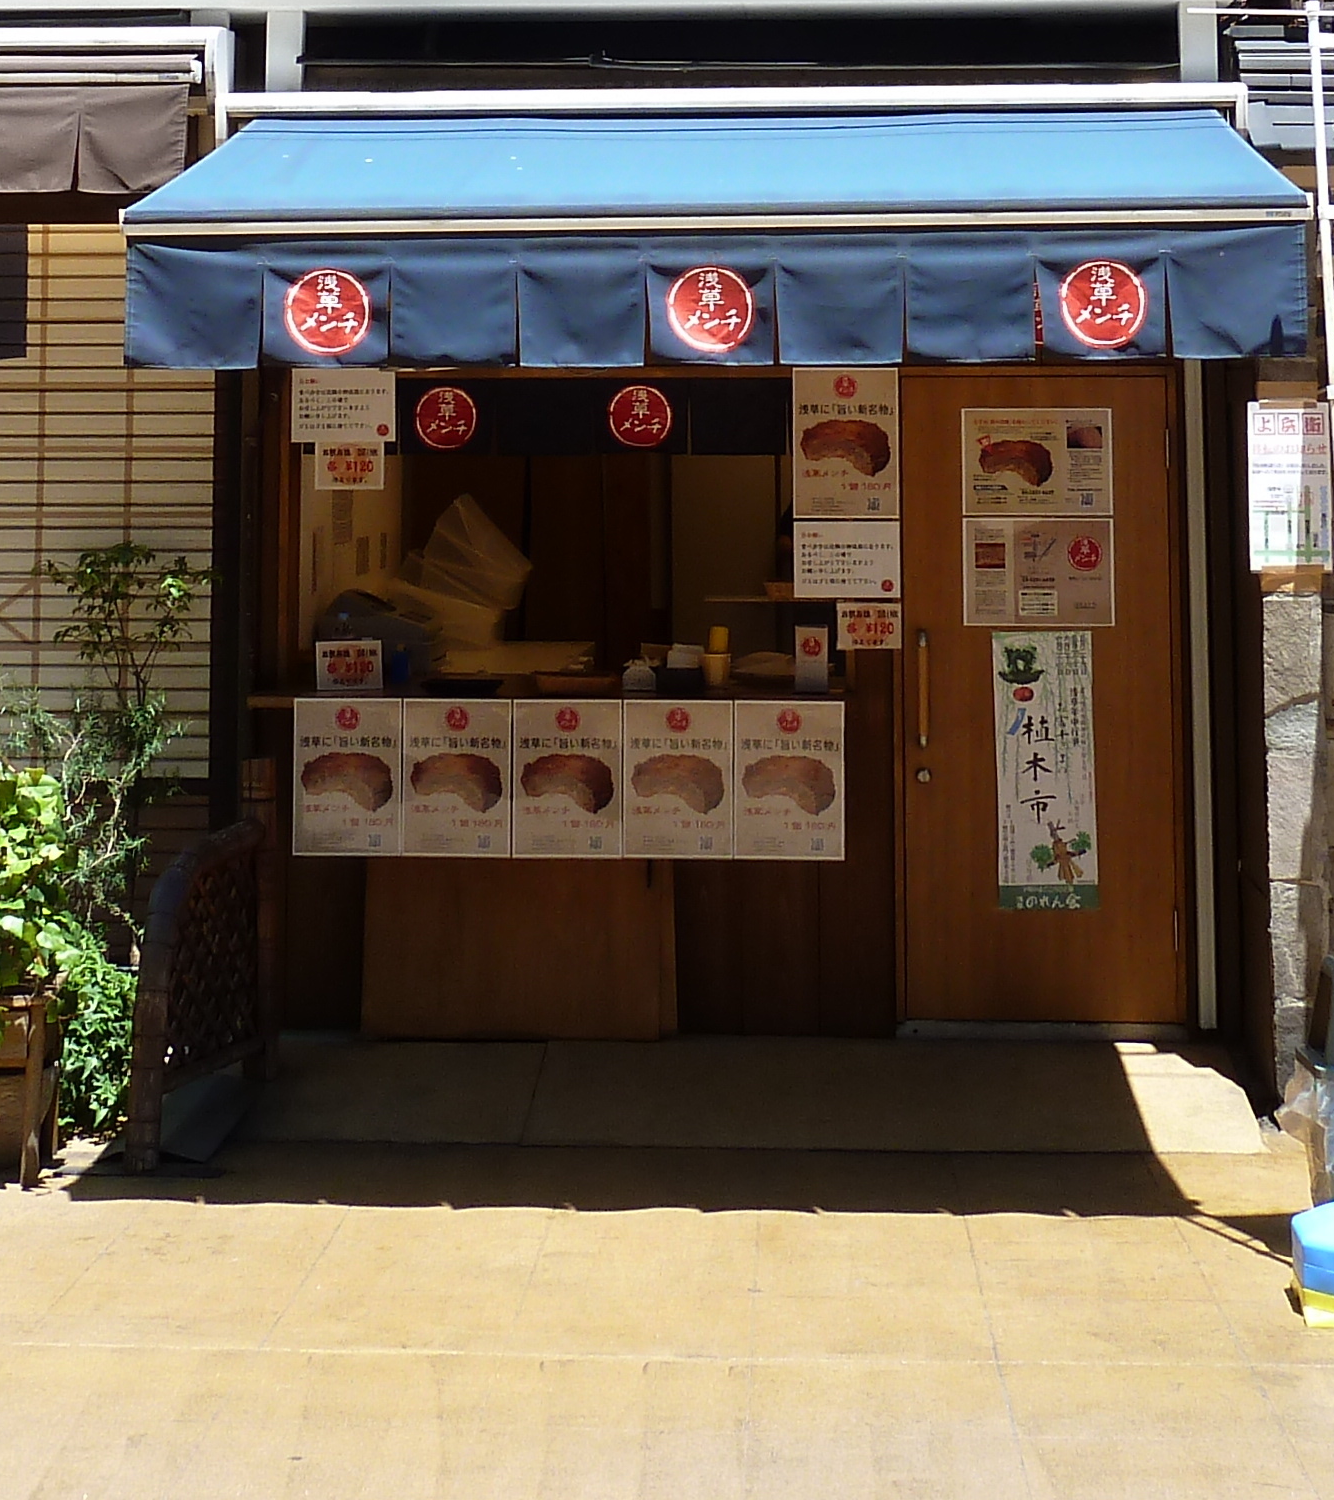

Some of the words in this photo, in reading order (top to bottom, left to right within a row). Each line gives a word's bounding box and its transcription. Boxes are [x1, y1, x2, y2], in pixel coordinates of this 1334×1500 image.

[698, 272, 725, 312] 浅草
[1089, 266, 1117, 306] 浅草
[316, 275, 343, 314] 浅草
[684, 309, 741, 331] メンチ
[1075, 303, 1134, 326] メンチ
[300, 312, 359, 334] メンチ
[437, 390, 456, 420] 浅草
[798, 404, 894, 416] 浅草に「旨い新名物」
[427, 419, 468, 435] メンチ
[620, 417, 662, 433] メンチ
[345, 460, 374, 473] ¥120
[866, 622, 894, 634] ¥120
[299, 736, 398, 749] 浅草に「旨い新名物」
[409, 737, 507, 750] 浅草に「旨い新名物」
[519, 737, 617, 750] 浅草に「旨い新名物」
[630, 737, 728, 750] 浅草に「旨い新名物」
[740, 738, 839, 751] 浅草に「旨い新名物」
[1020, 715, 1057, 824] 植木市
